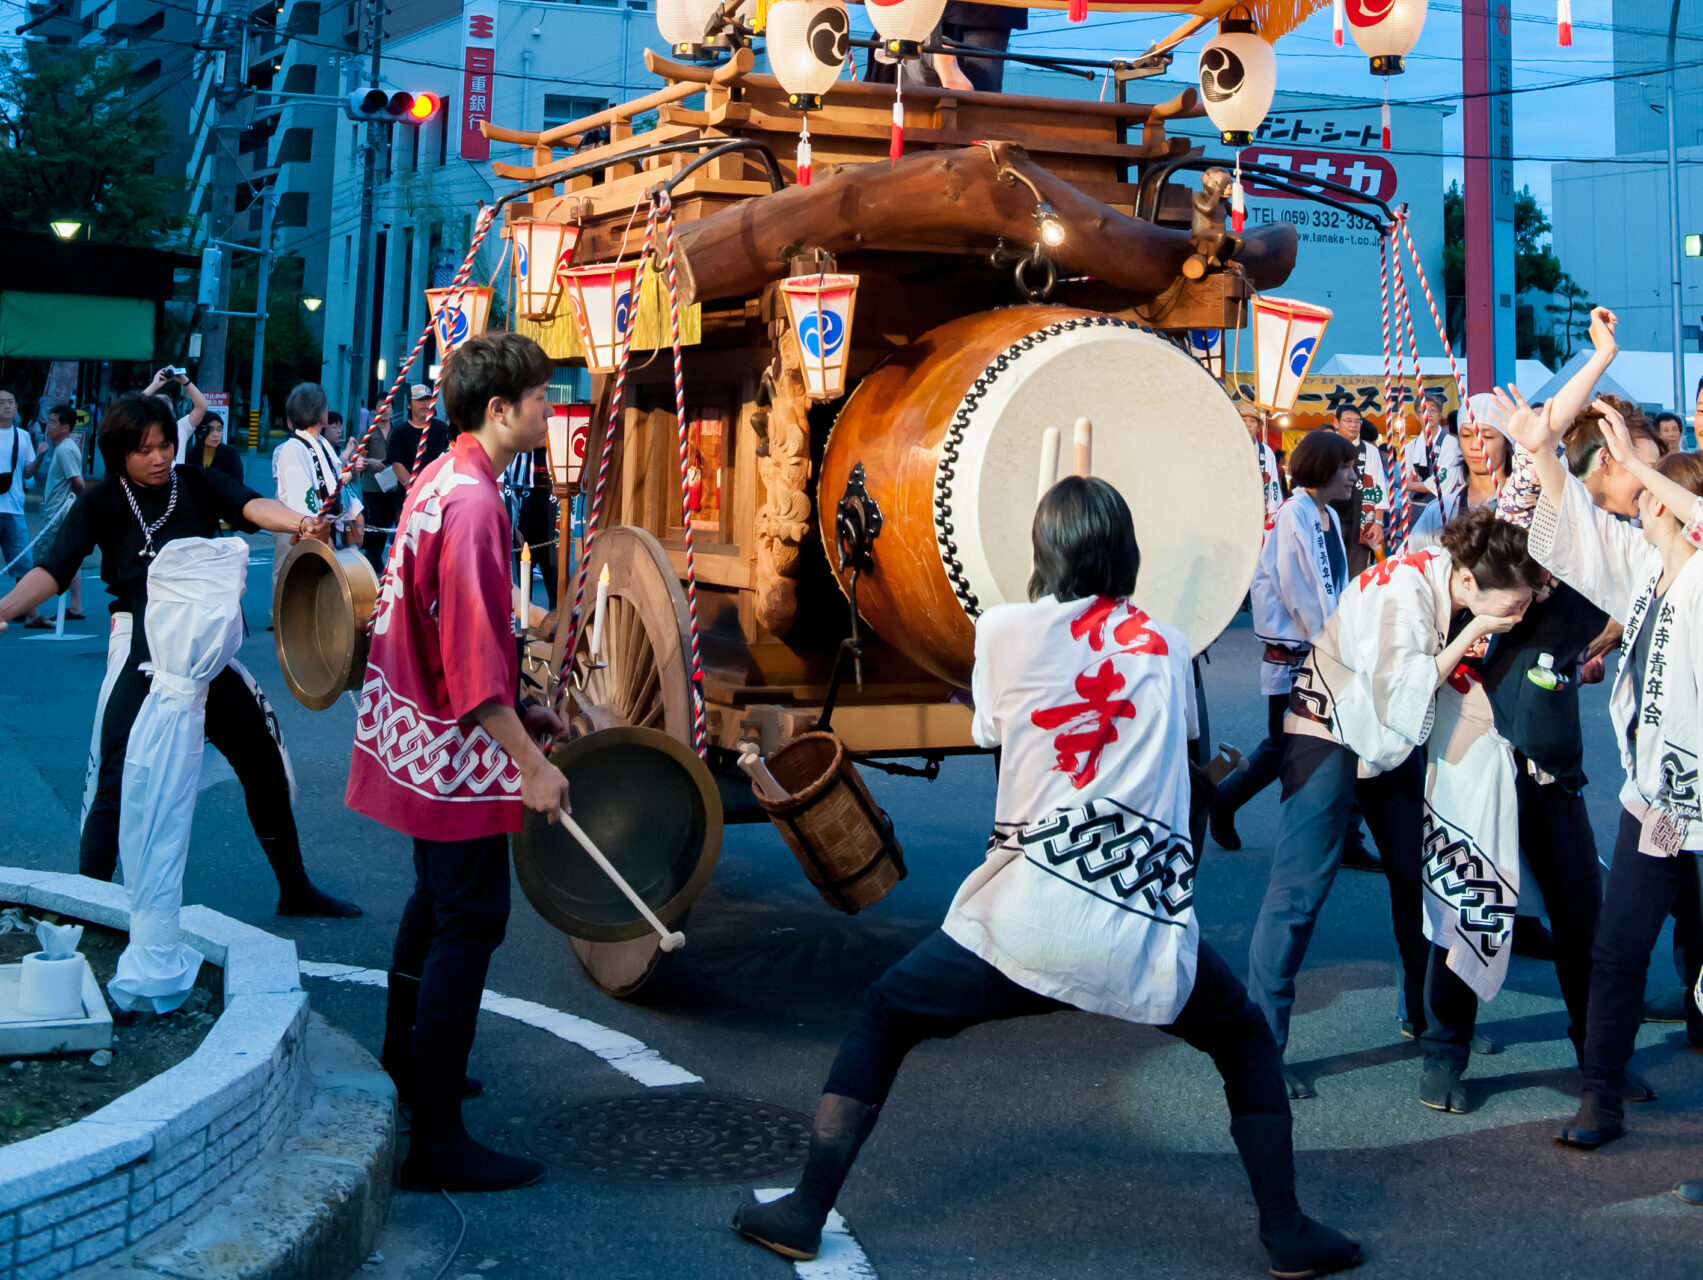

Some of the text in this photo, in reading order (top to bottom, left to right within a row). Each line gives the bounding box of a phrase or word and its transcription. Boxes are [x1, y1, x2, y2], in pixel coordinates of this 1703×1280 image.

[468, 56, 487, 131] 三重銀行
[1252, 207, 1278, 224] TEL
[1281, 209, 1310, 226] (059)
[1643, 601, 1676, 727] 松寺青年会
